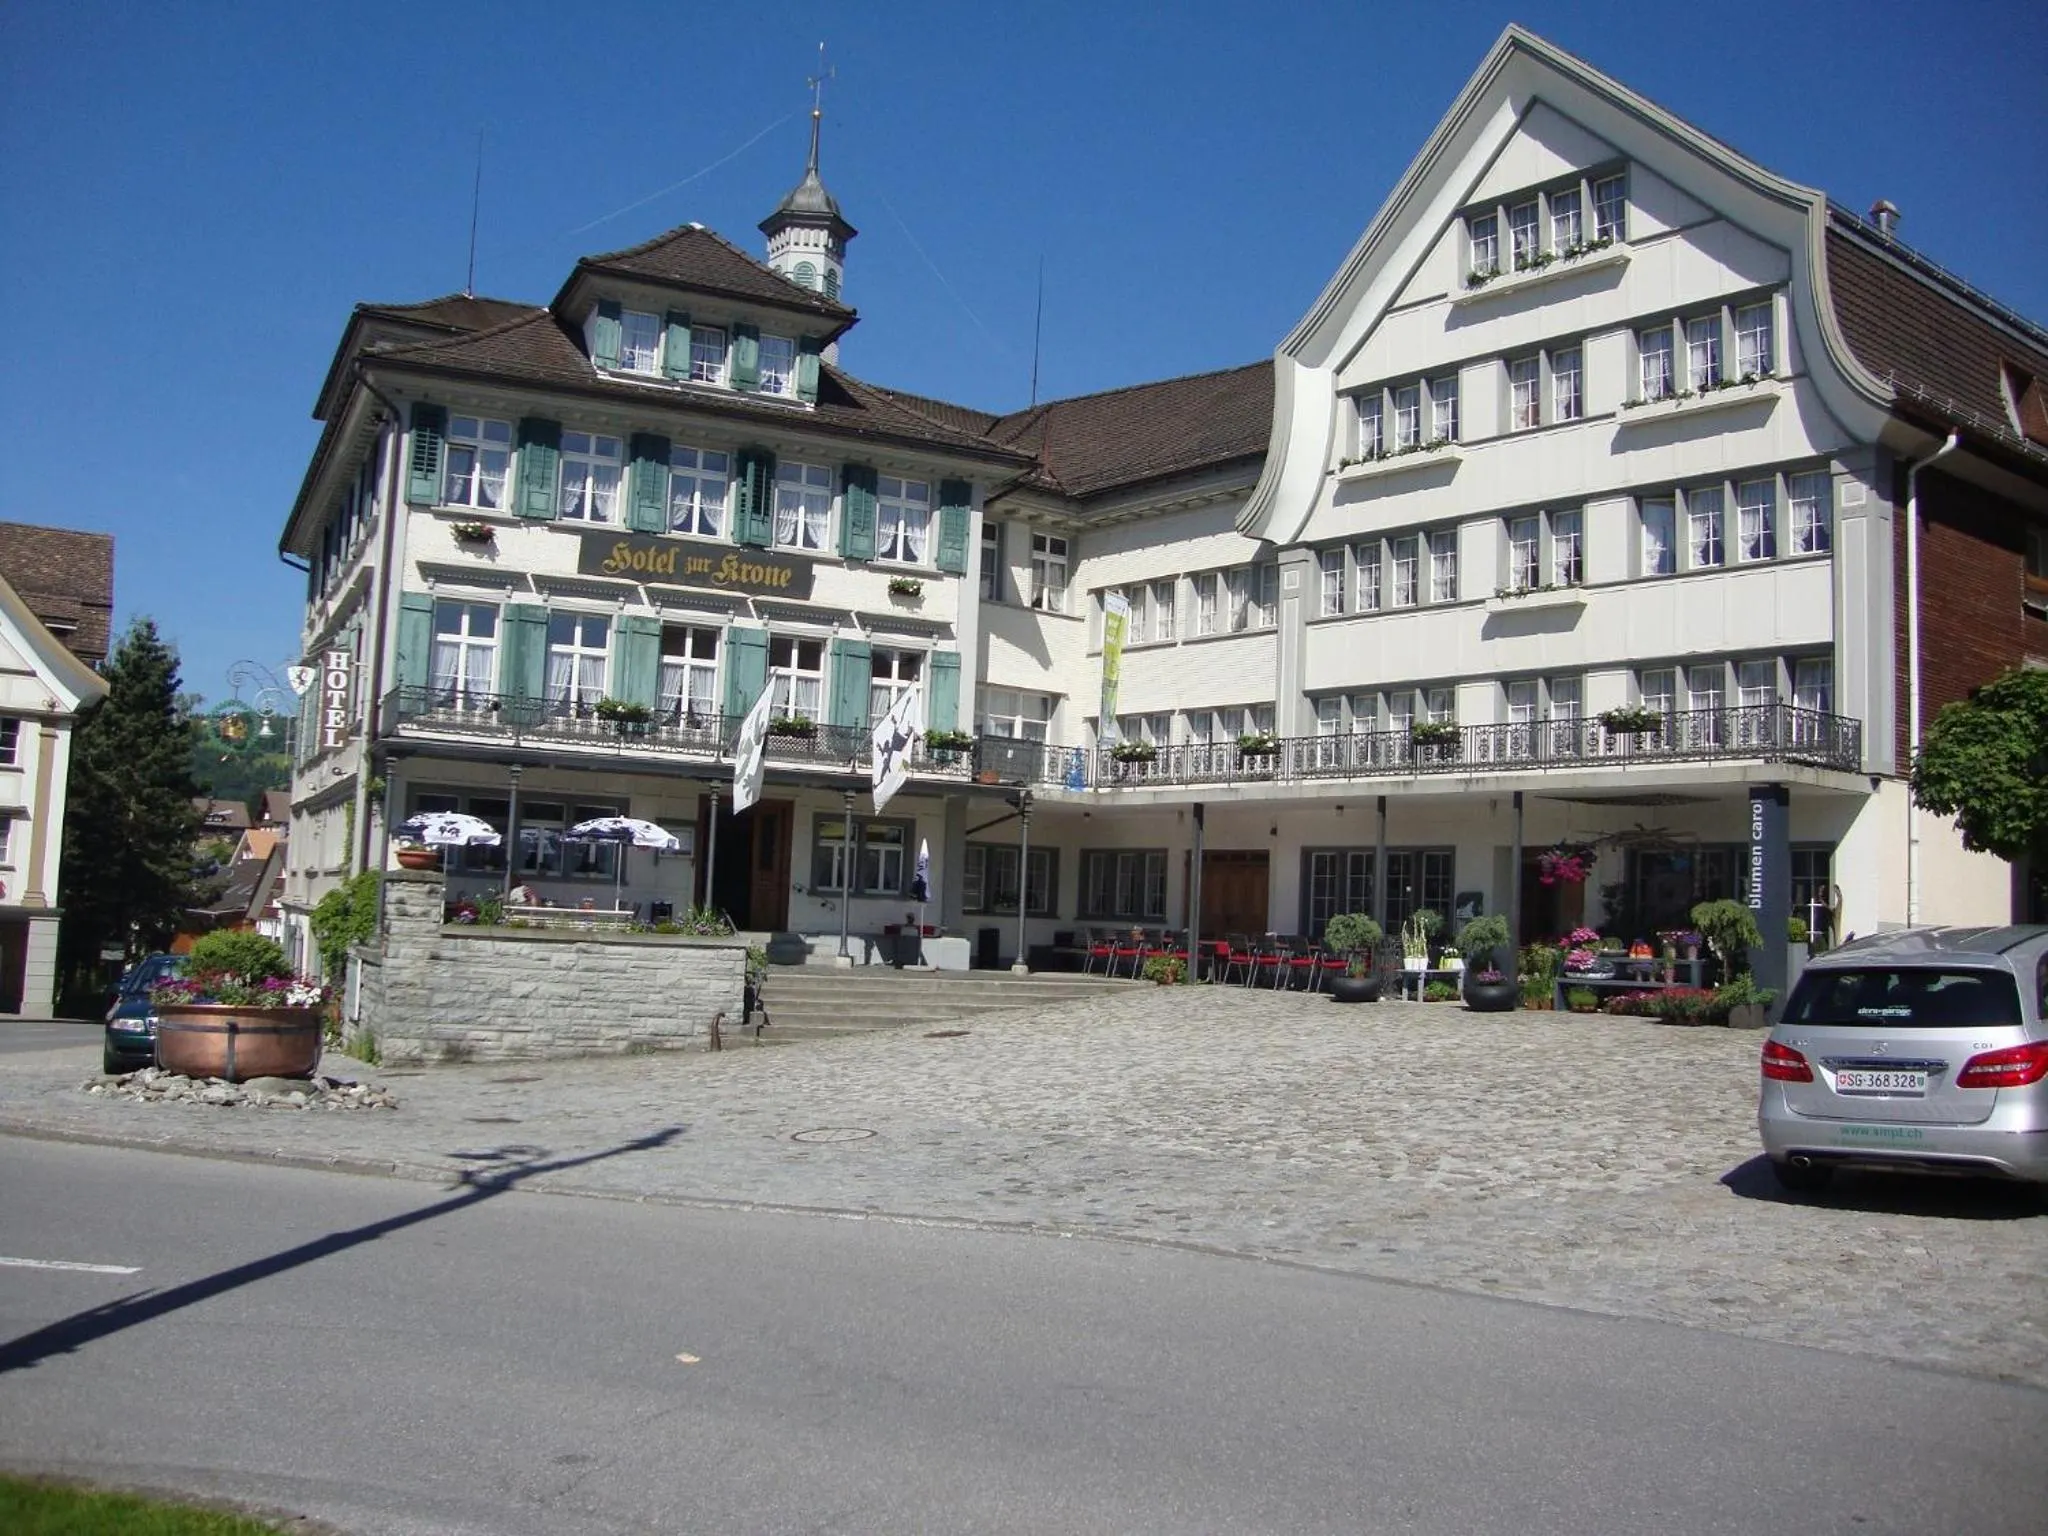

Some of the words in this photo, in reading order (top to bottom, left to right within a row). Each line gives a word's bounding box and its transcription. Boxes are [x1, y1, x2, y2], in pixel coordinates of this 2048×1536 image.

[602, 541, 680, 574] Hotel
[684, 557, 712, 574] zur
[711, 553, 792, 588] Krone
[323, 651, 351, 747] HOTEL
[1750, 799, 1762, 840] carol
[1748, 845, 1762, 908] blumen
